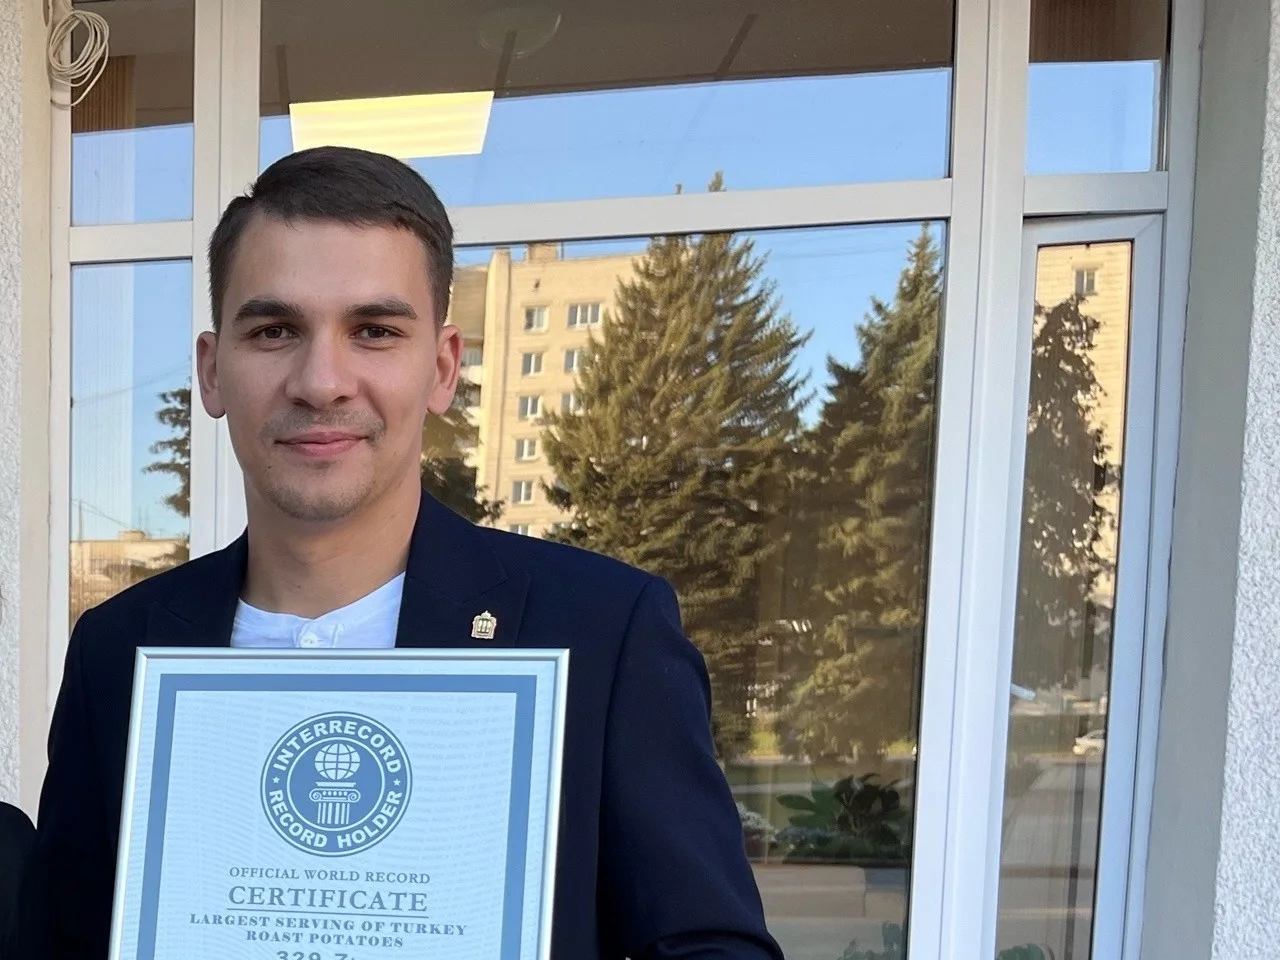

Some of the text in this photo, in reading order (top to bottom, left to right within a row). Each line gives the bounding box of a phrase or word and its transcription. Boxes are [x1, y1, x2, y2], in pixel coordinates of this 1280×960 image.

[272, 719, 402, 774] INTERRECORD
[268, 788, 402, 849] RECORD HOLDER
[229, 866, 430, 884] OFFICIAL WORLD RECORD
[228, 885, 429, 913] CERTIFICATE
[189, 913, 467, 937] LARGEST SERVING OF TURKEY
[246, 931, 404, 948] ROAST POTATOES
